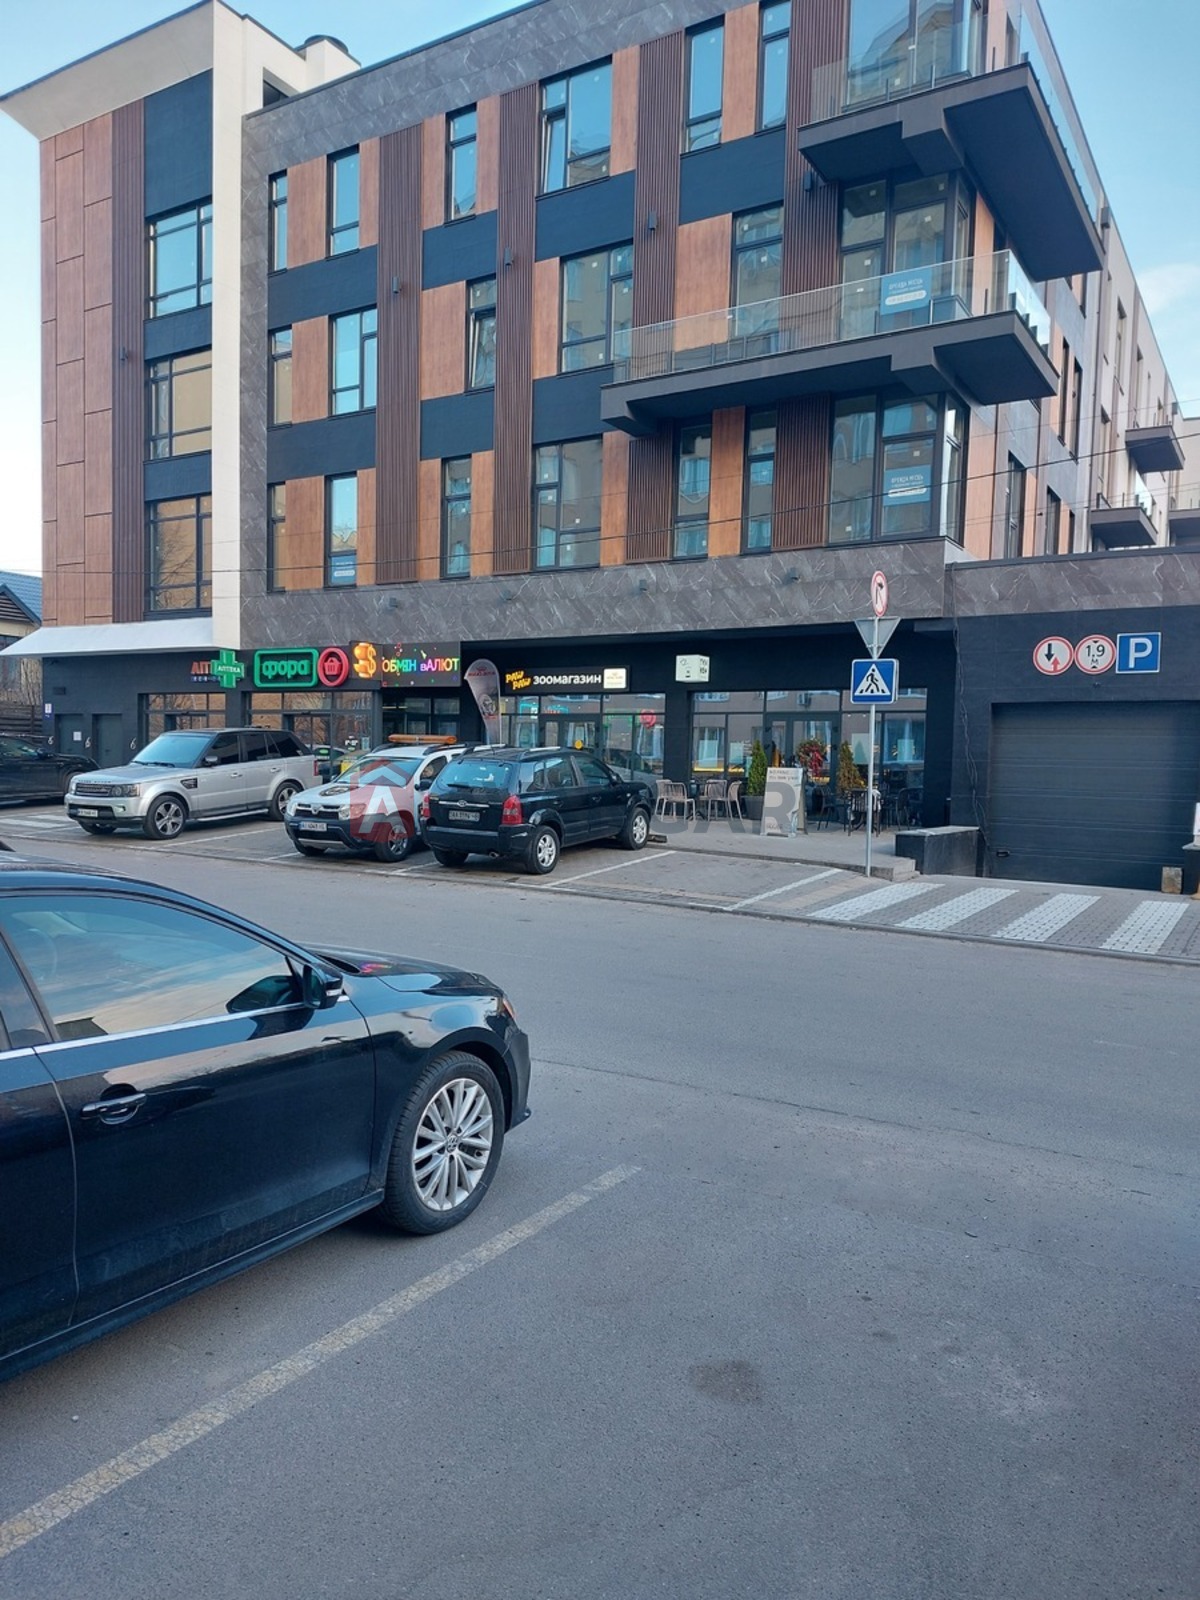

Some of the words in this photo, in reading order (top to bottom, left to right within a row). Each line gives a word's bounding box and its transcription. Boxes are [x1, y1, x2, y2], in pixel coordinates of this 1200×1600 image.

[1129, 637, 1152, 668] P
[217, 665, 241, 673] АПТЕКА
[505, 670, 524, 683] PAW
[512, 677, 531, 690] PAW
